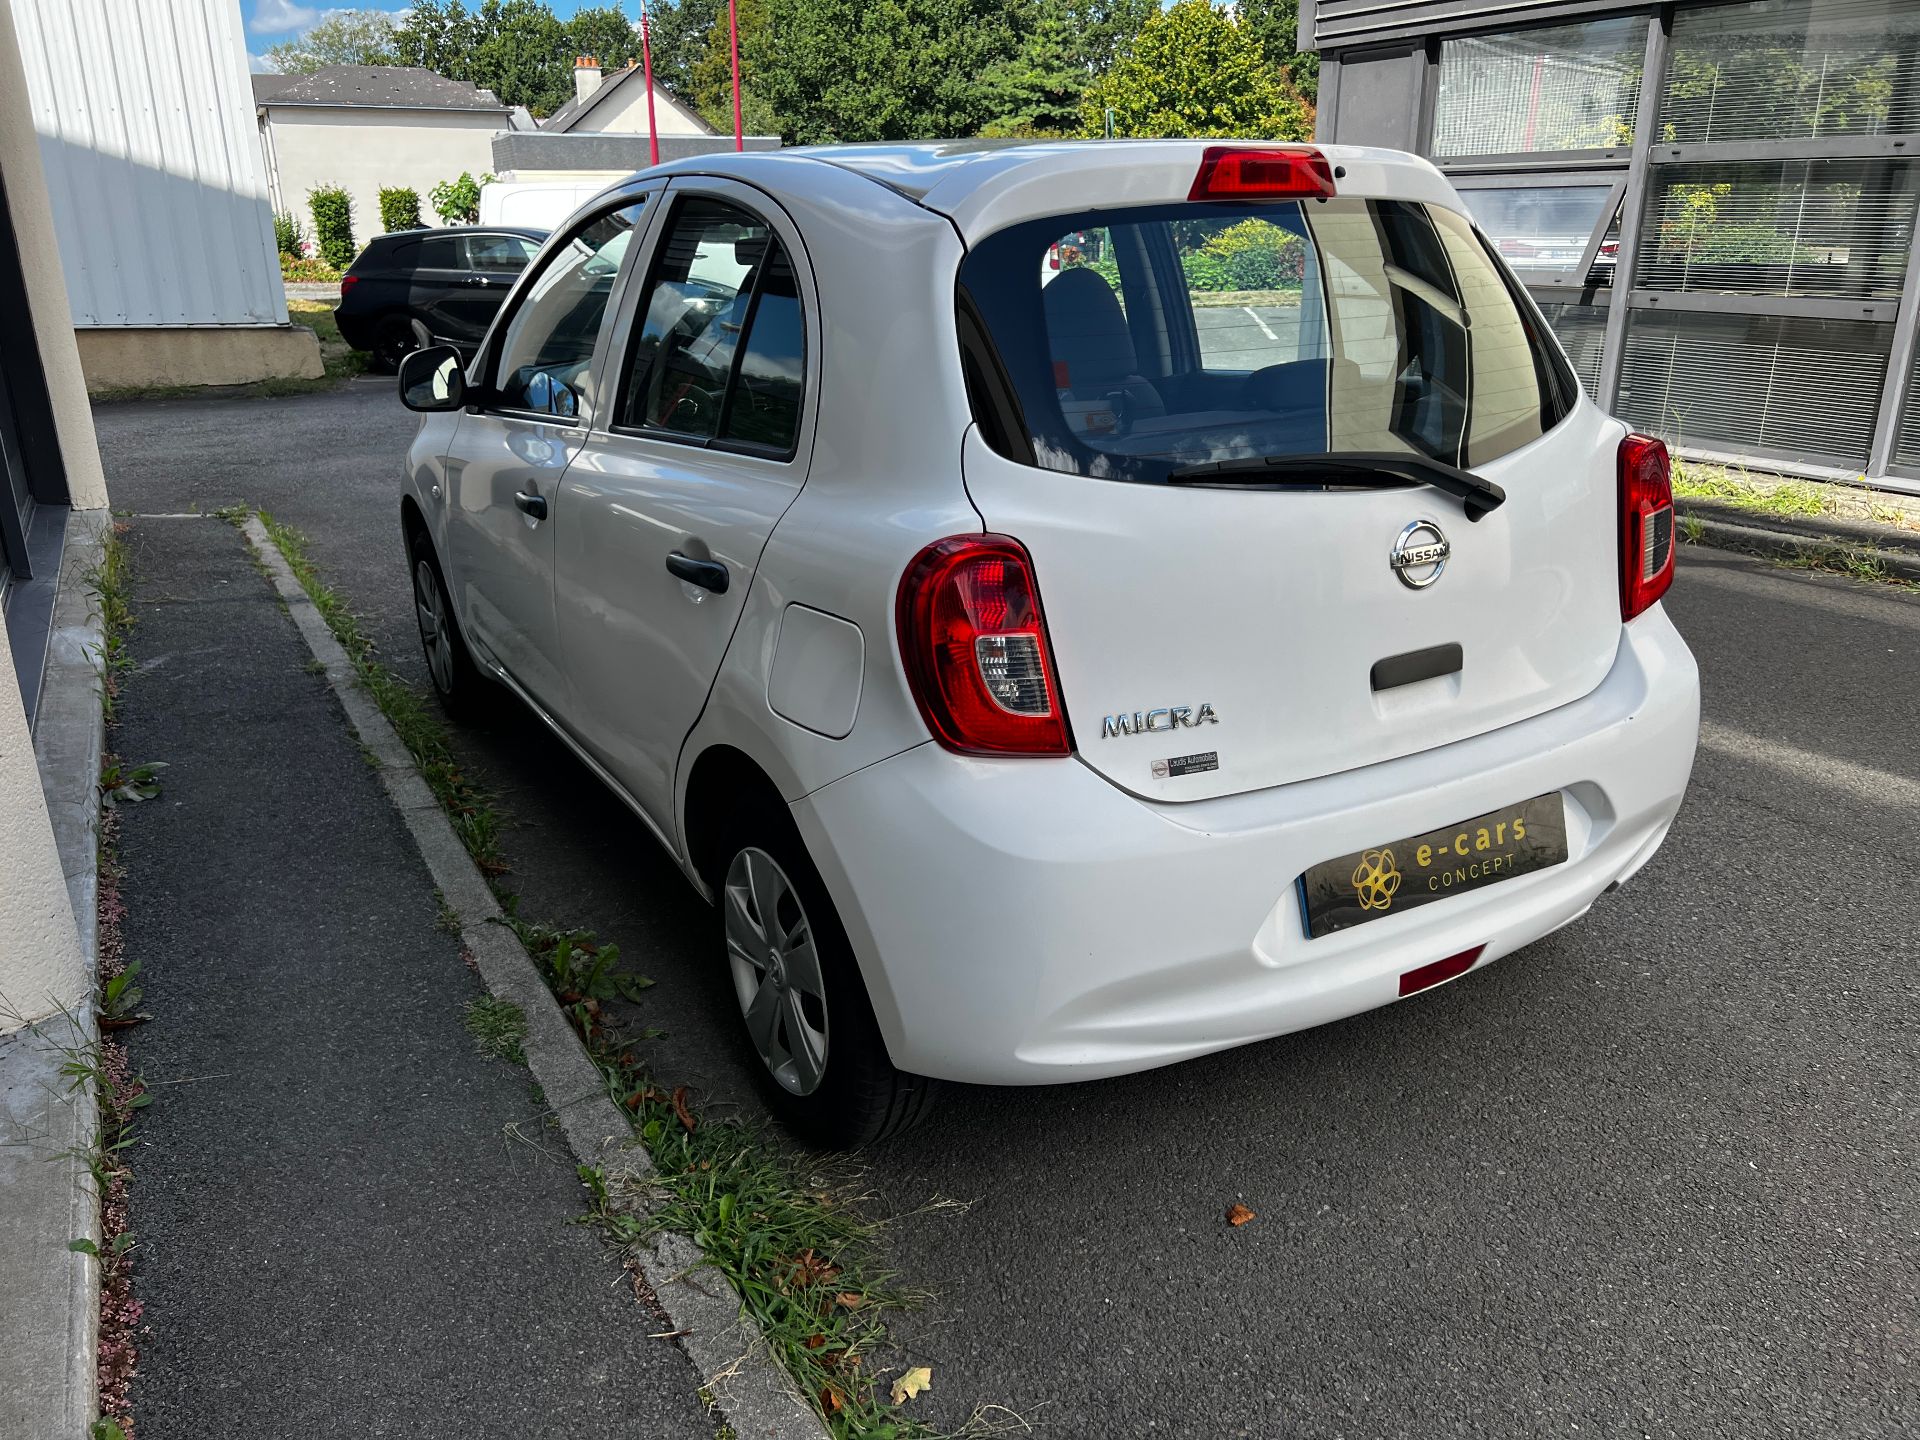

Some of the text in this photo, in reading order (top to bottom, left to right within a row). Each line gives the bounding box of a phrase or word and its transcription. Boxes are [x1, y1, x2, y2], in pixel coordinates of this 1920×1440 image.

[1400, 545, 1447, 564] NISSAN
[1101, 702, 1220, 739] MICRA
[1187, 752, 1217, 765] Automobiles
[1416, 817, 1527, 867] e-cars
[1428, 853, 1515, 891] CONCEPT
